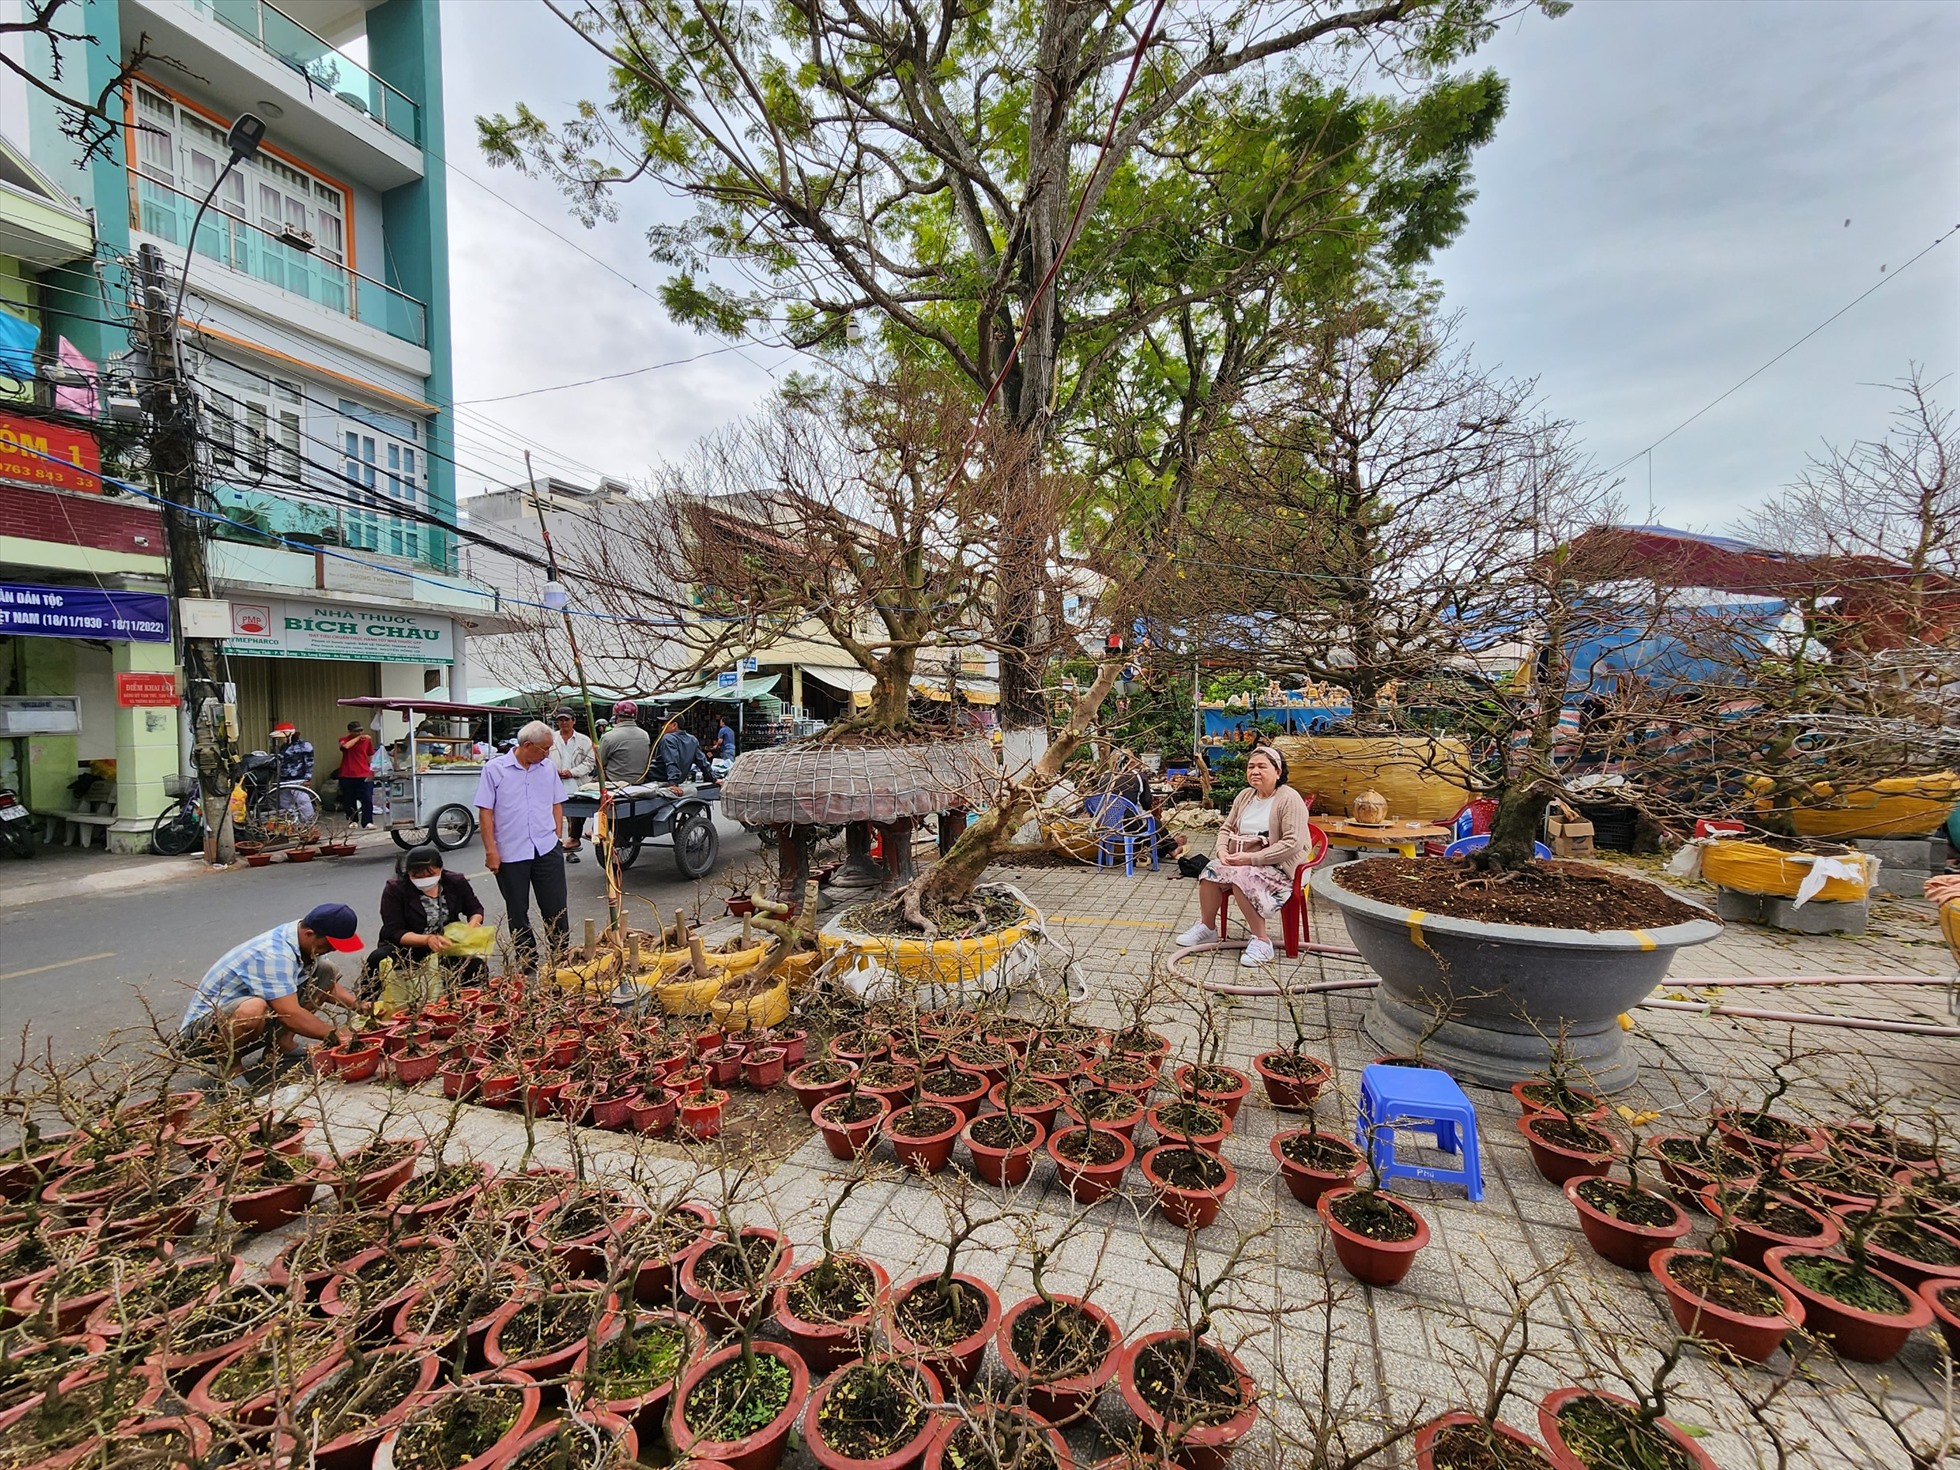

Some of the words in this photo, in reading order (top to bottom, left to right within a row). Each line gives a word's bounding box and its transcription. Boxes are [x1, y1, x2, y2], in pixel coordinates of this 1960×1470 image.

[68, 445, 84, 468] 1
[35, 469, 64, 482] 843
[76, 477, 94, 488] 33
[17, 590, 41, 605] DÂN
[42, 592, 64, 609] TỘC
[12, 611, 40, 625] NAM
[43, 614, 102, 629] (18/11/1930
[111, 619, 164, 634] 18/11/2022)
[242, 615, 262, 624] PMP
[315, 608, 354, 619] NHÀ
[358, 612, 417, 625] THUỐC
[284, 617, 358, 635] BÍCH
[366, 624, 440, 640] CHÂU
